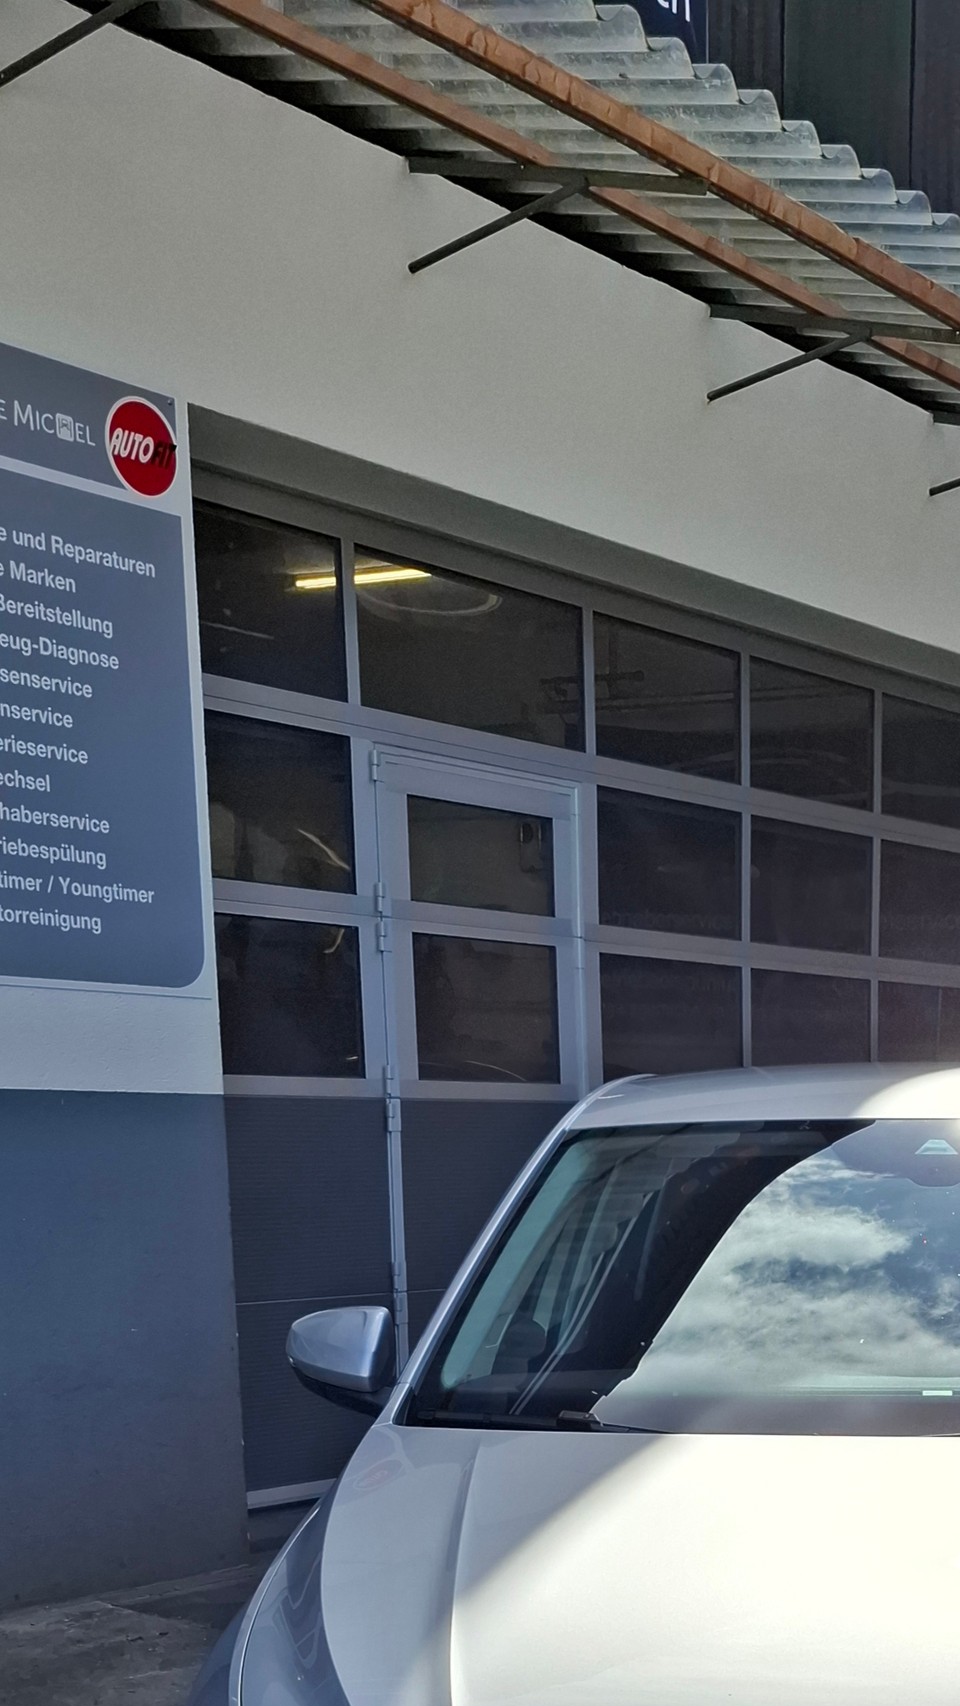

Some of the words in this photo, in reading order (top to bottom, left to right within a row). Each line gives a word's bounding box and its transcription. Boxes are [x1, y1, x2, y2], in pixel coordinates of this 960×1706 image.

[12, 529, 46, 551] und
[51, 535, 156, 578] Reparaturen
[9, 559, 76, 593] Marken
[0, 666, 93, 699] senservice
[58, 876, 155, 904] Youngtimer
